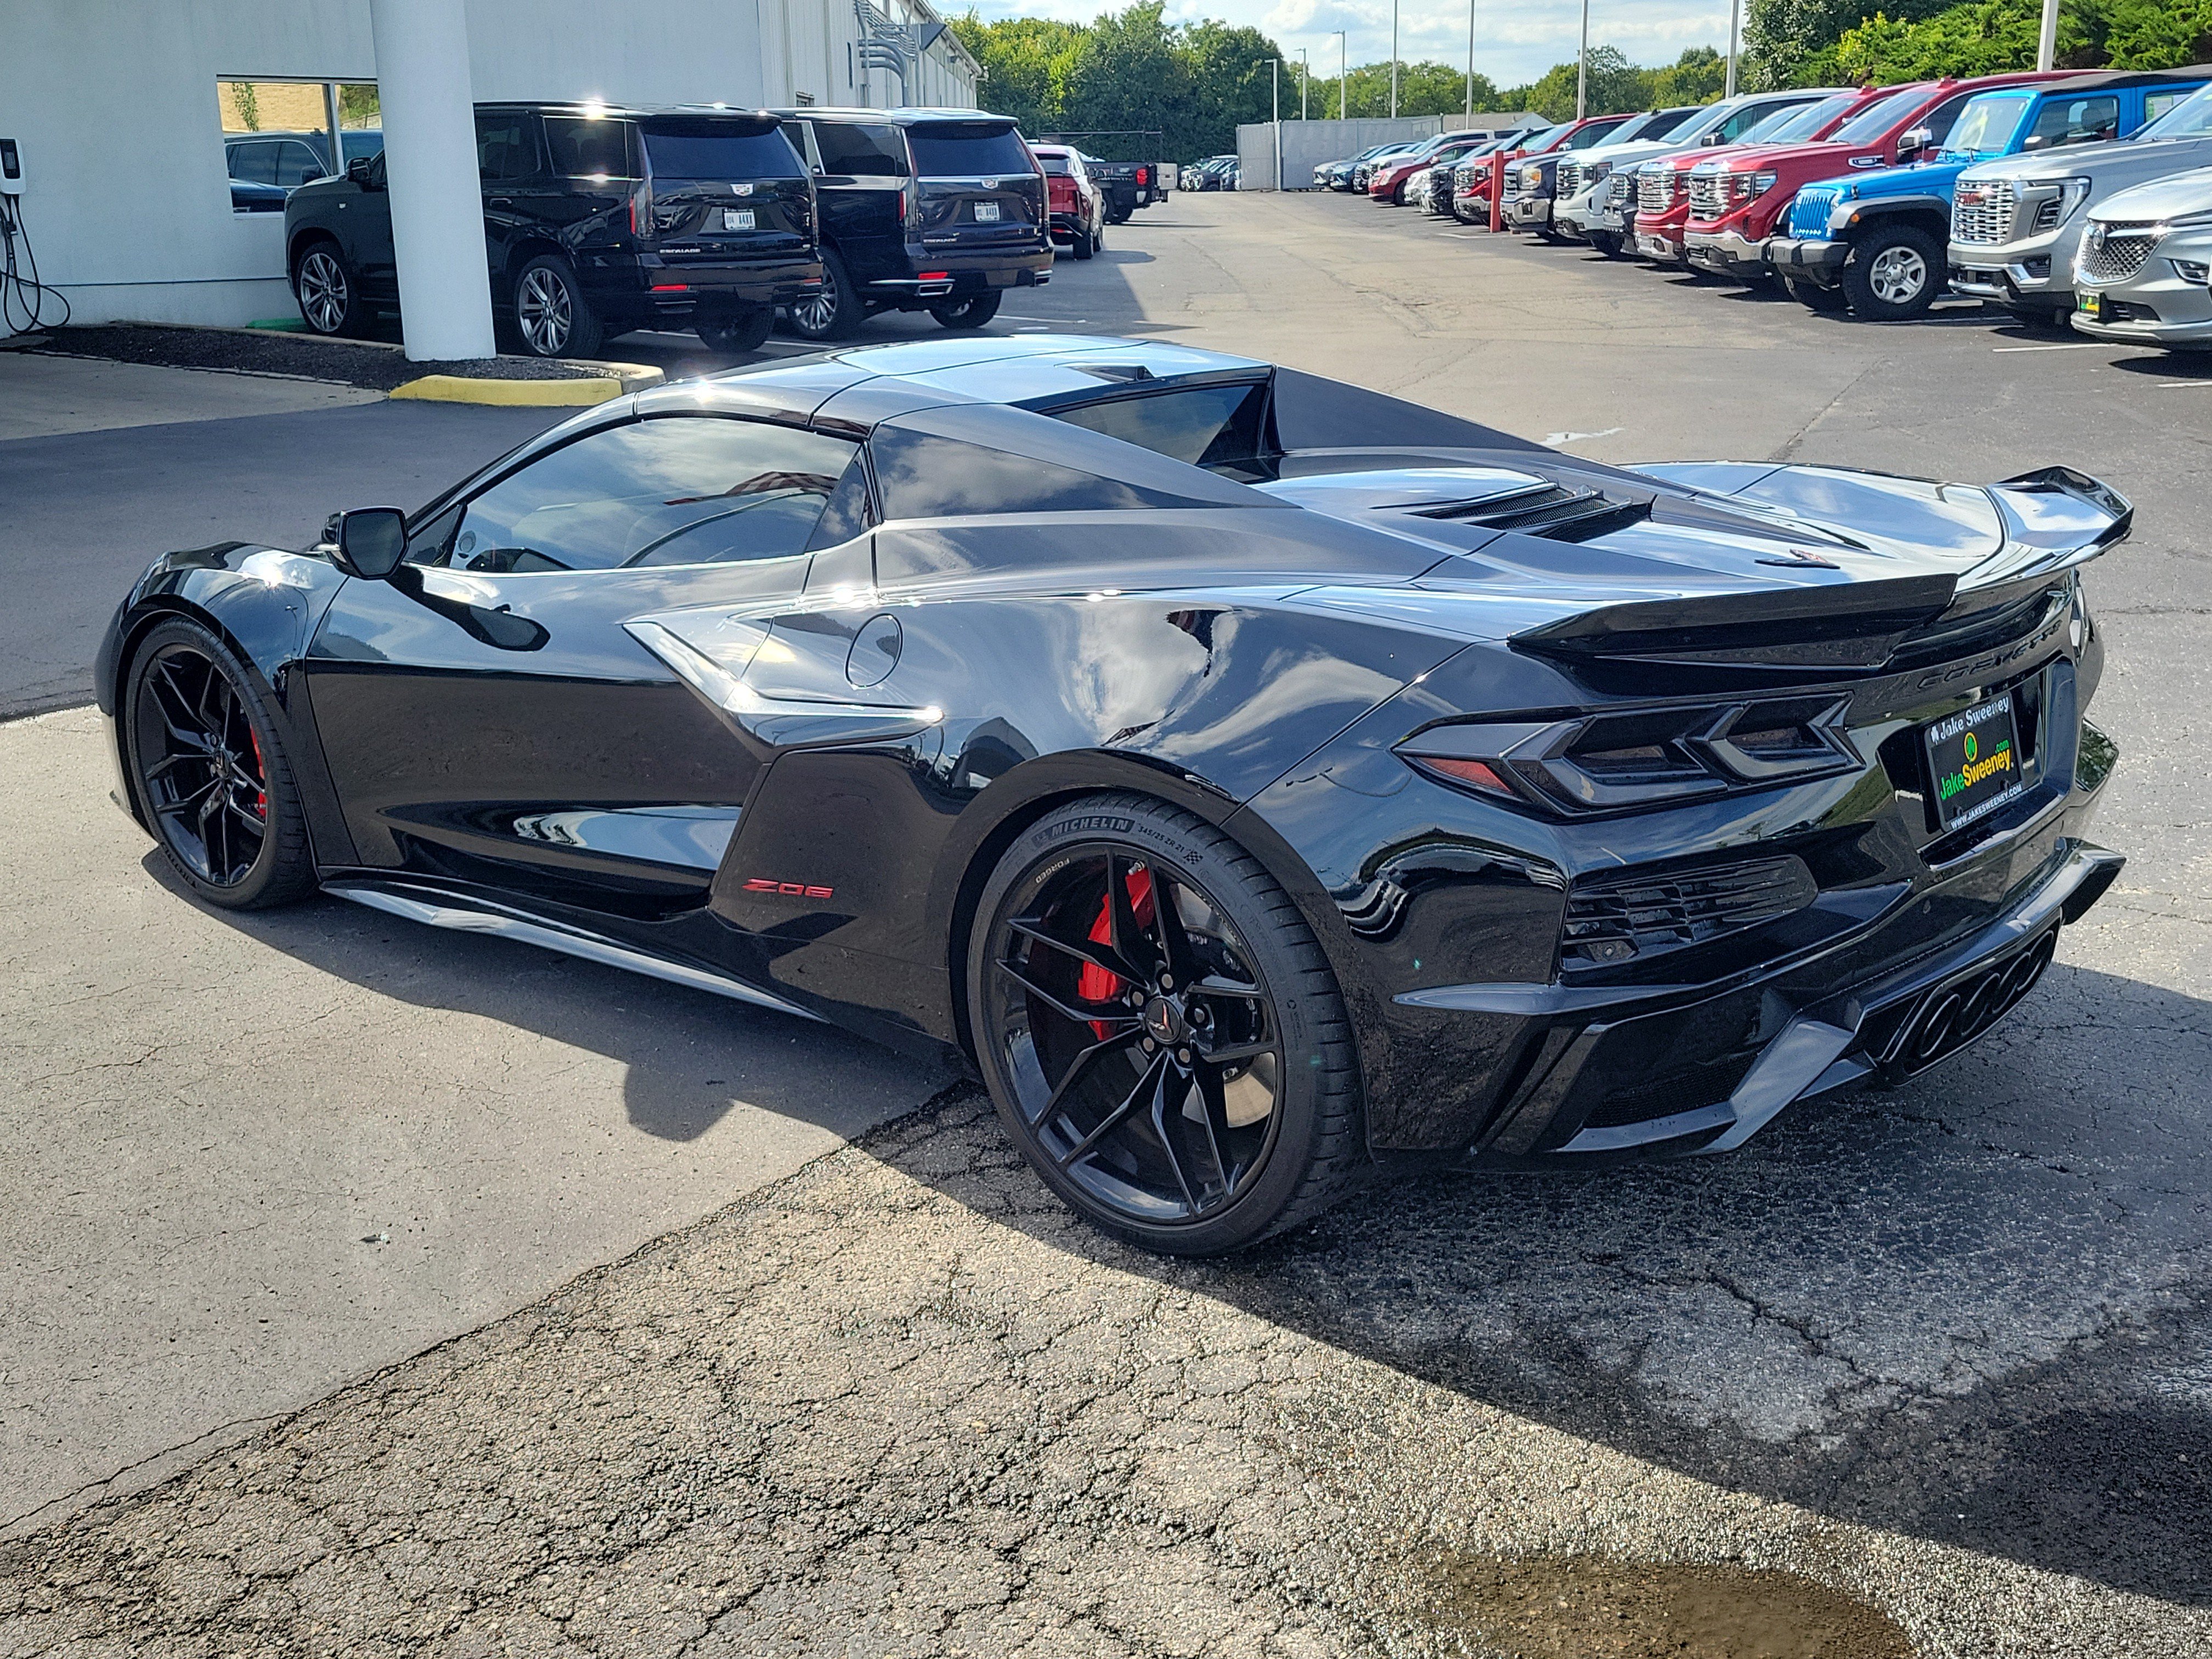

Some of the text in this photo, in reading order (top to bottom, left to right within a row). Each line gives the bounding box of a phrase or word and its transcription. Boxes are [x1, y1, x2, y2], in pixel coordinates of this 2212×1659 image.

[1940, 696, 2008, 740] Jake Sweeney
[1950, 783, 2022, 830] WWW.JAKESWEENEY.COM
[1052, 817, 1129, 837] MICHELIN
[1138, 826, 1165, 841] 345/25
[1164, 838, 1175, 847] ZR
[742, 878, 834, 899] Z06
